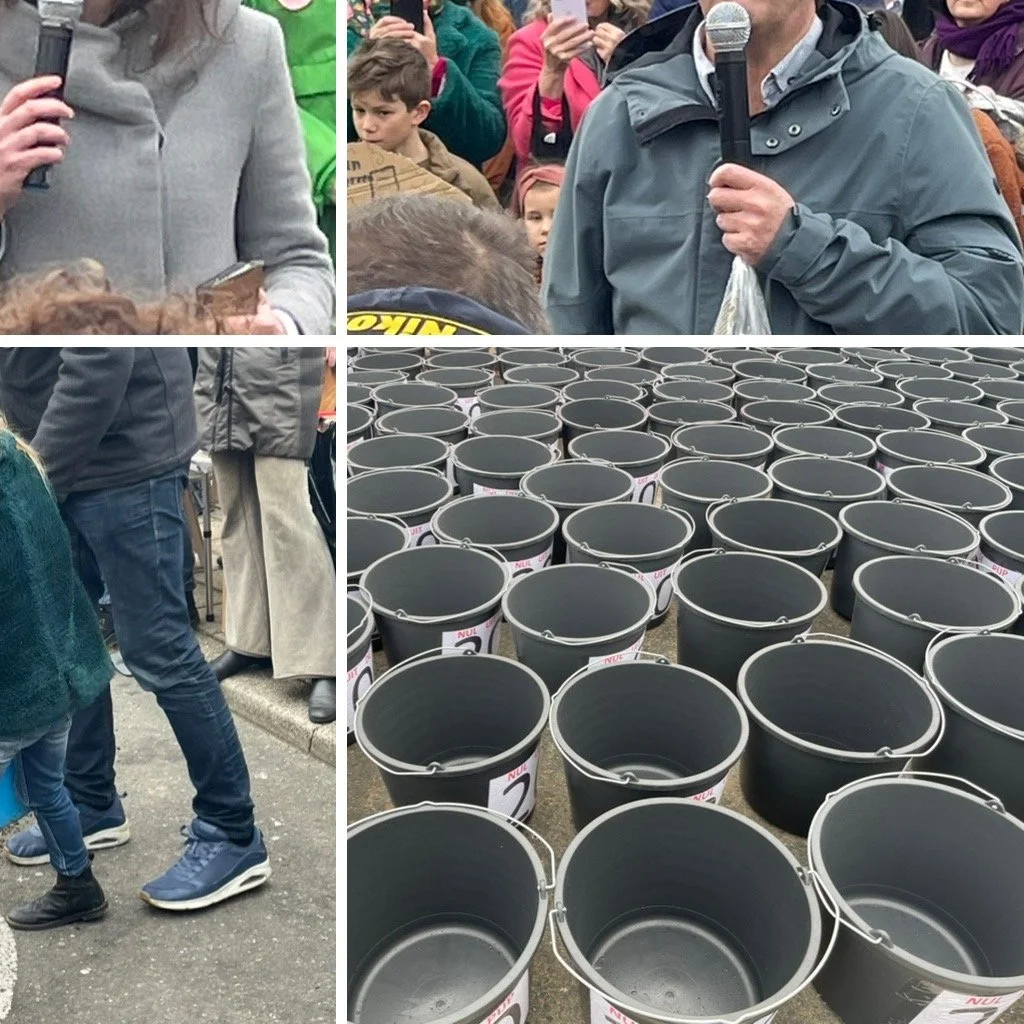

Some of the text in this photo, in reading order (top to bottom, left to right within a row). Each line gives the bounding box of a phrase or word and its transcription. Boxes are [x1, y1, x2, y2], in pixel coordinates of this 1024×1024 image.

[347, 314, 457, 335] Niko
[514, 560, 532, 569] NUL
[457, 628, 478, 638] NUL
[604, 655, 624, 664] NUL
[507, 763, 529, 782] NUL
[965, 997, 1002, 1005] NUL
